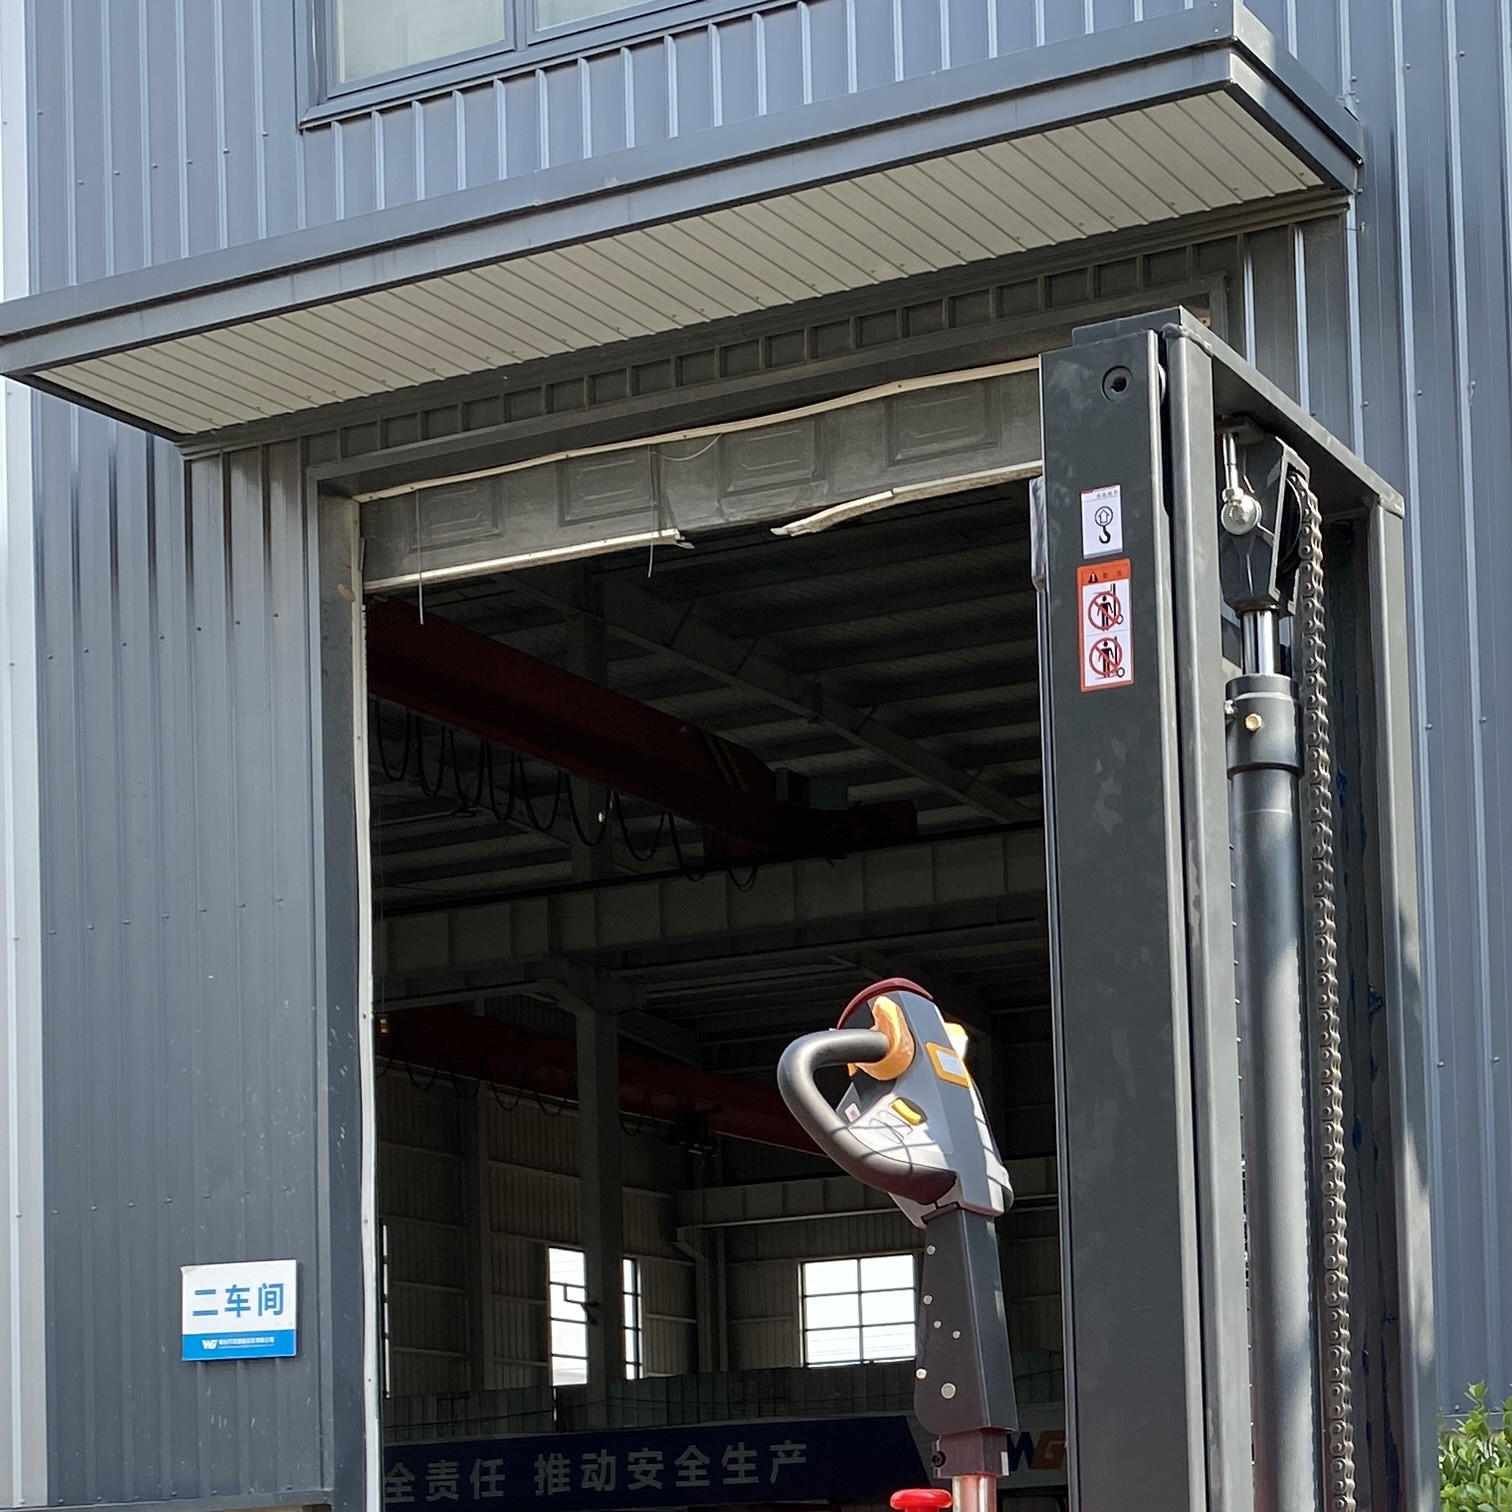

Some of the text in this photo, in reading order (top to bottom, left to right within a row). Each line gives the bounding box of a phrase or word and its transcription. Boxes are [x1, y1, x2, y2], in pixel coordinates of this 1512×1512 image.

[192, 1282, 285, 1318] 二车间
[384, 1439, 808, 1504] 全责任 推动安全生产
